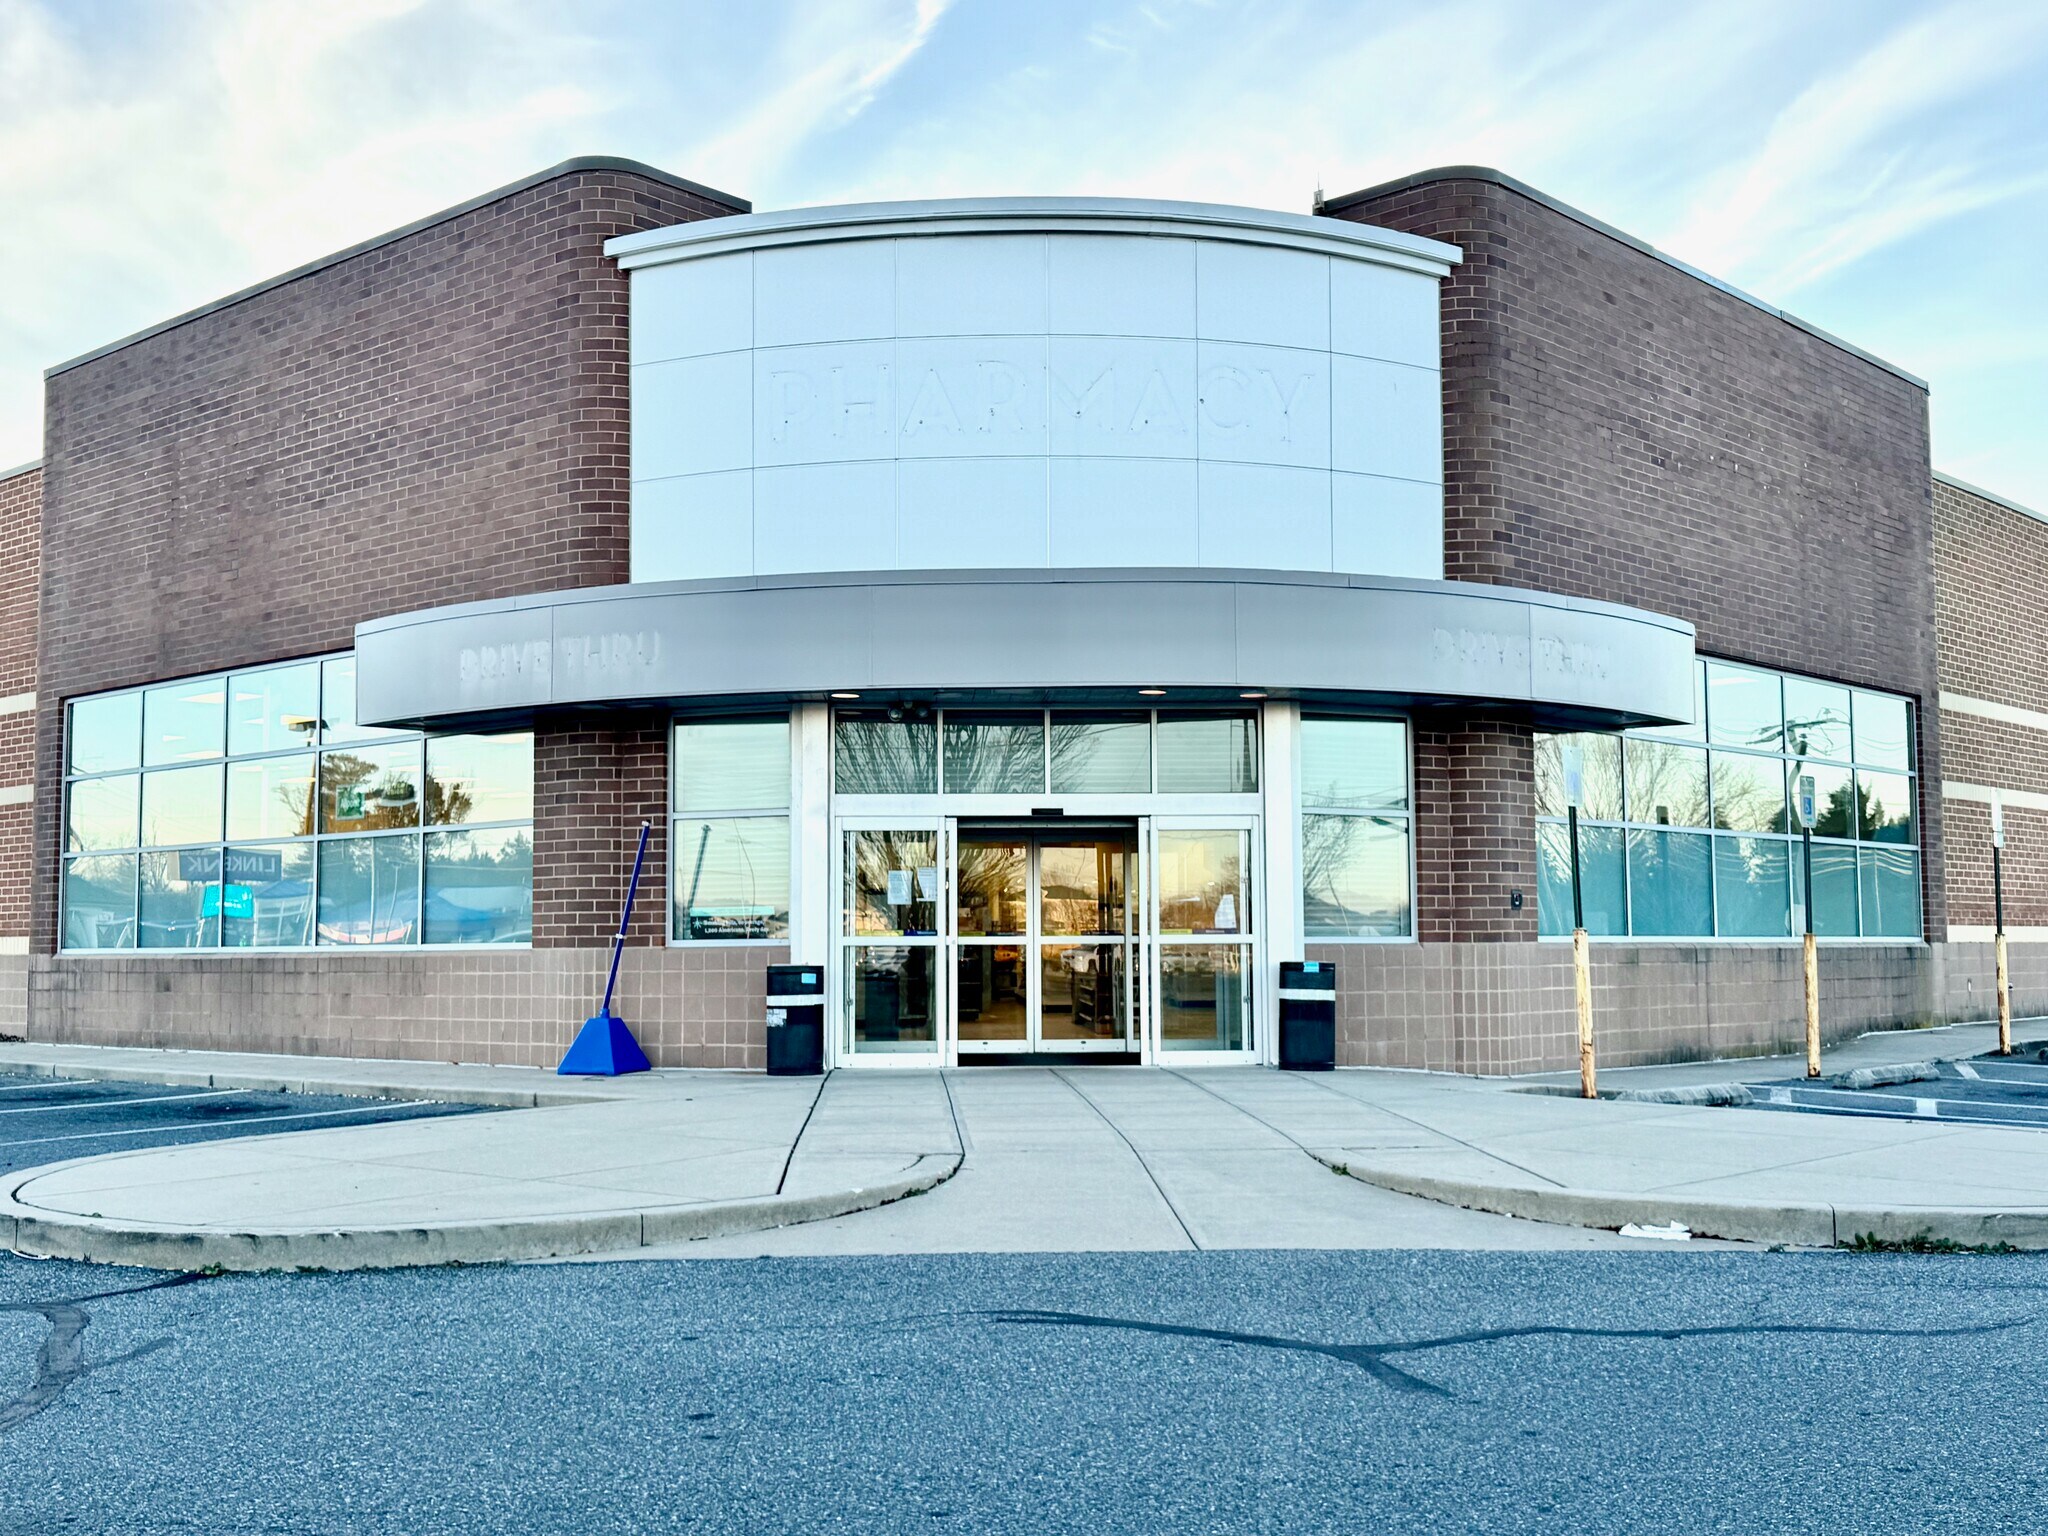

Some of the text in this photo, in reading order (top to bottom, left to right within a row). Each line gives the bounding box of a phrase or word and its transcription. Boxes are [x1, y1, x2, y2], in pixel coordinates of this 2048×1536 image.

[771, 359, 1317, 443] PHARMACY
[459, 630, 661, 682] DRIVE THRU
